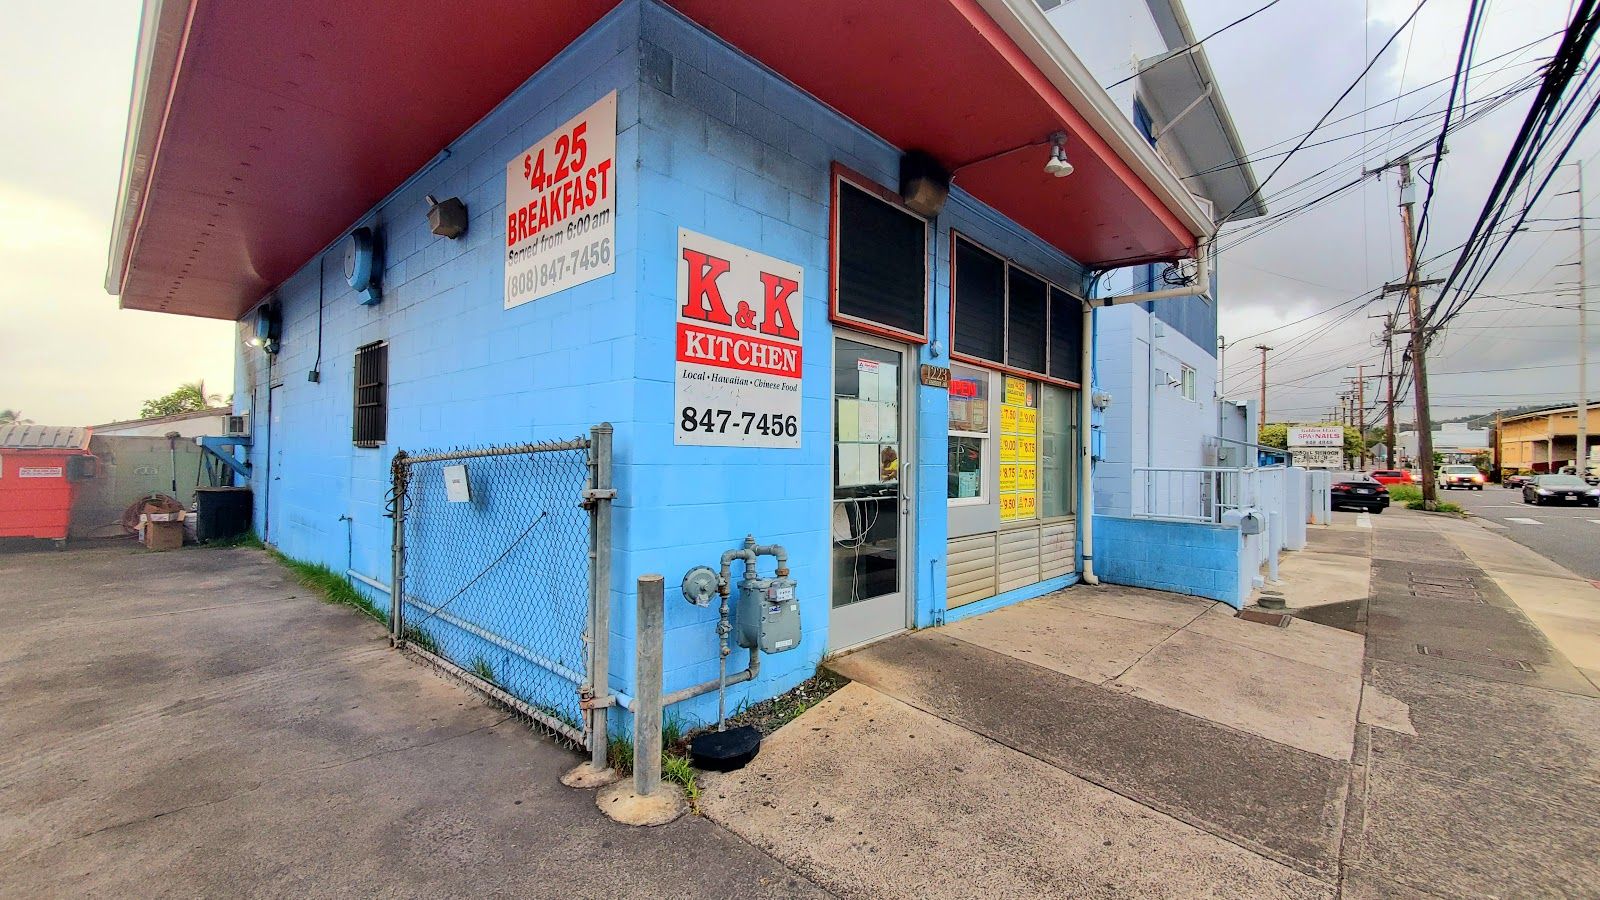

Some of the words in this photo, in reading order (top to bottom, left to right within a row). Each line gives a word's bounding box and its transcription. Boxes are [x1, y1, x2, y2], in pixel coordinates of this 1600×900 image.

[524, 120, 587, 193] $4.25
[508, 158, 611, 247] BREAKFAST
[508, 237, 538, 267] Served
[540, 230, 563, 253] from
[540, 237, 611, 287] 847-7456
[735, 300, 757, 330] &
[684, 330, 798, 372] KITCHEN
[682, 369, 706, 380] Local
[711, 373, 749, 386] Hawaiian
[753, 378, 780, 391] Chinese
[781, 382, 798, 392] Food
[926, 365, 948, 382] 1223
[681, 406, 798, 437] 847-7456
